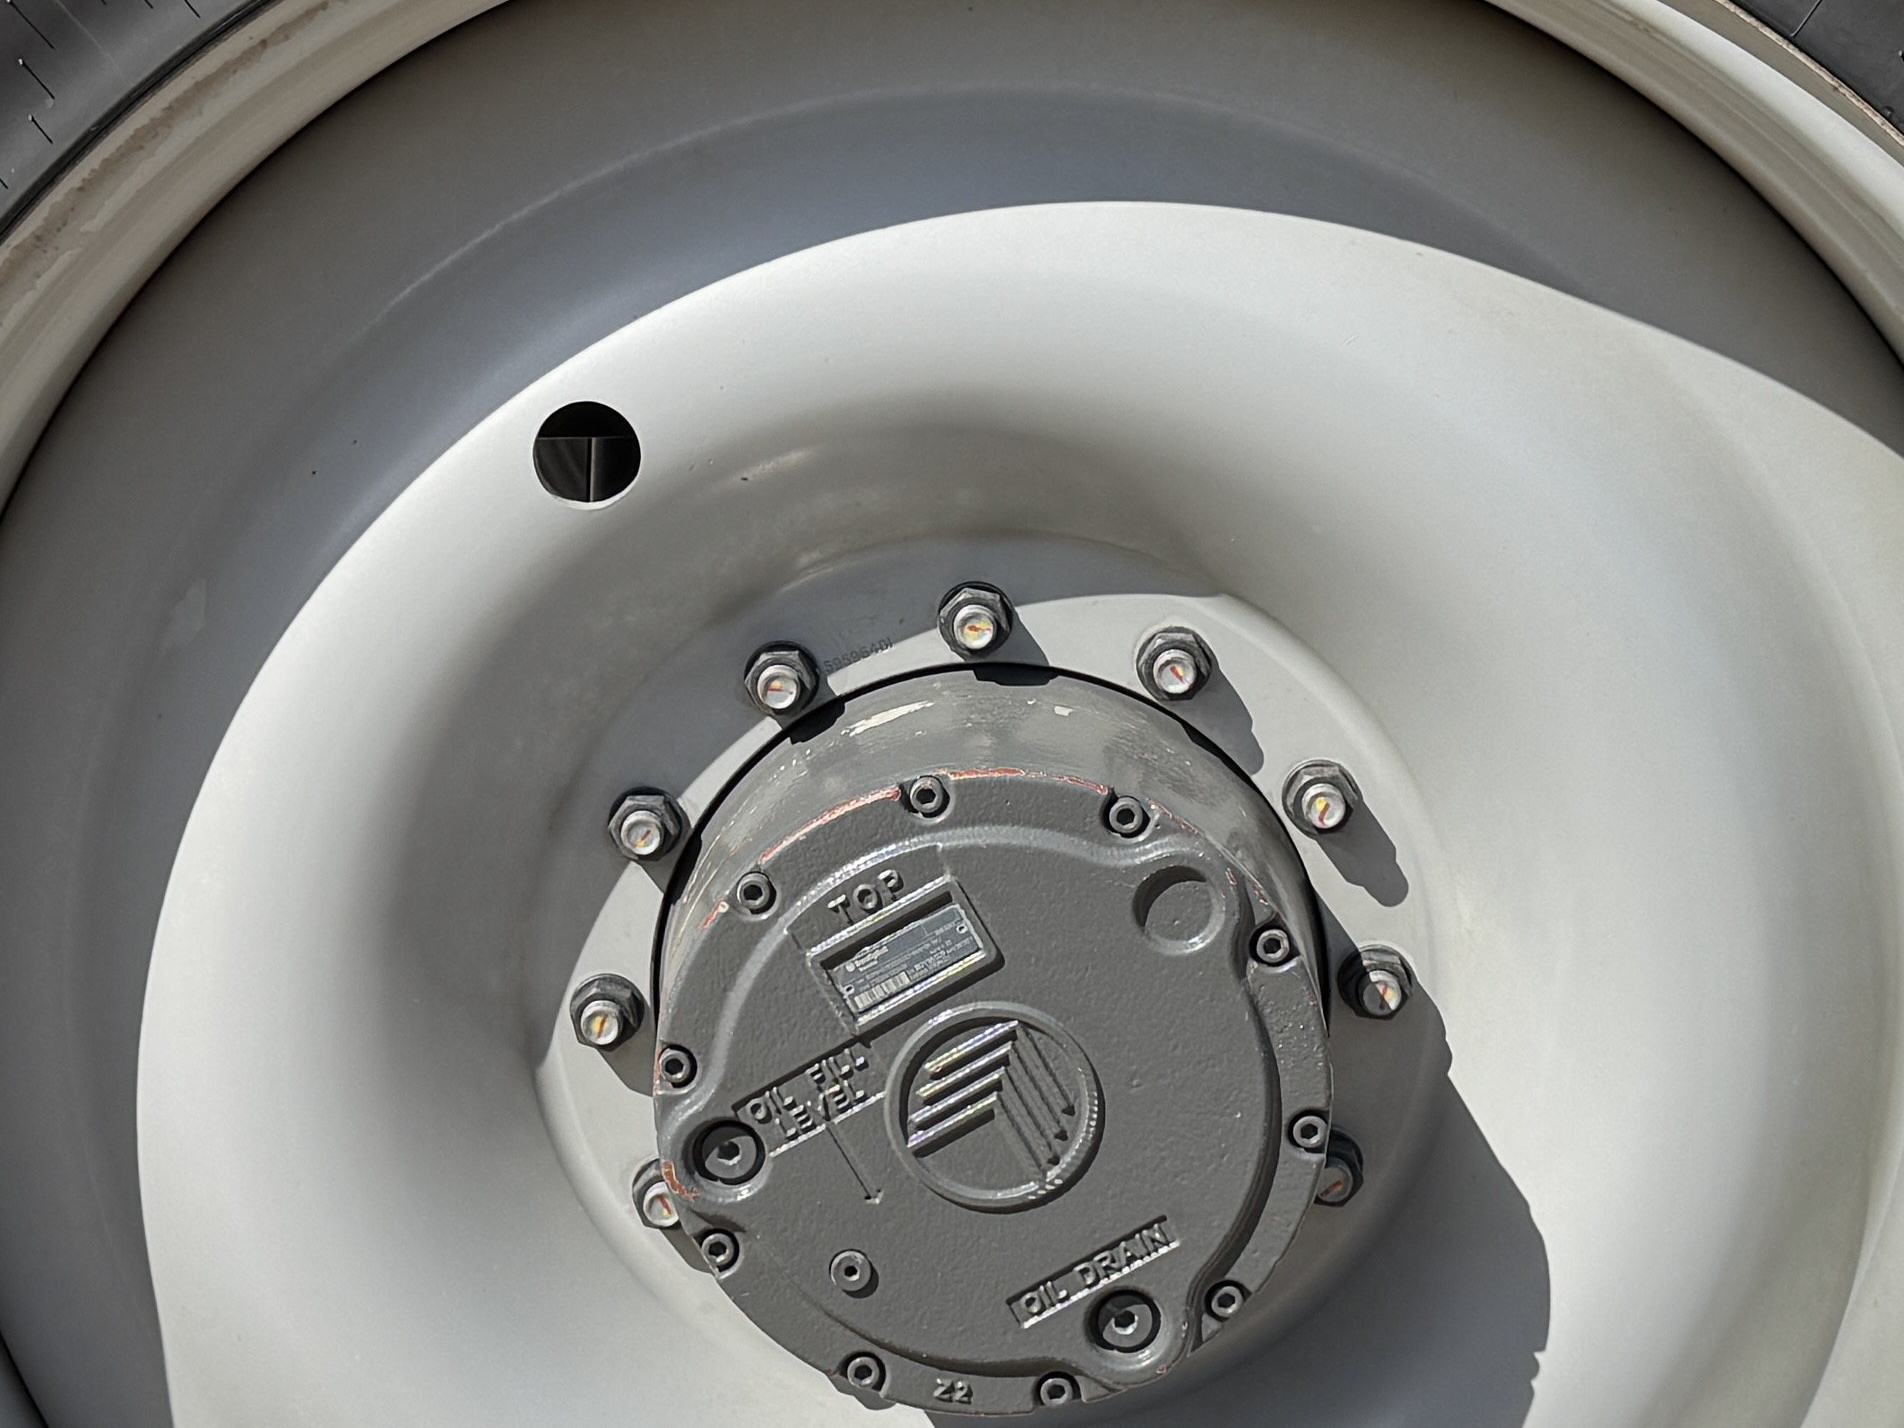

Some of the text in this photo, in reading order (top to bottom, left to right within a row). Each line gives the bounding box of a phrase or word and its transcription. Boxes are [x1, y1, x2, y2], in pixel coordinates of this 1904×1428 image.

[826, 868, 906, 923] TOP
[743, 1042, 870, 1127] OIL FILL
[772, 1074, 869, 1142] LEVEL
[1016, 1223, 1173, 1318] OIL DRAIN
